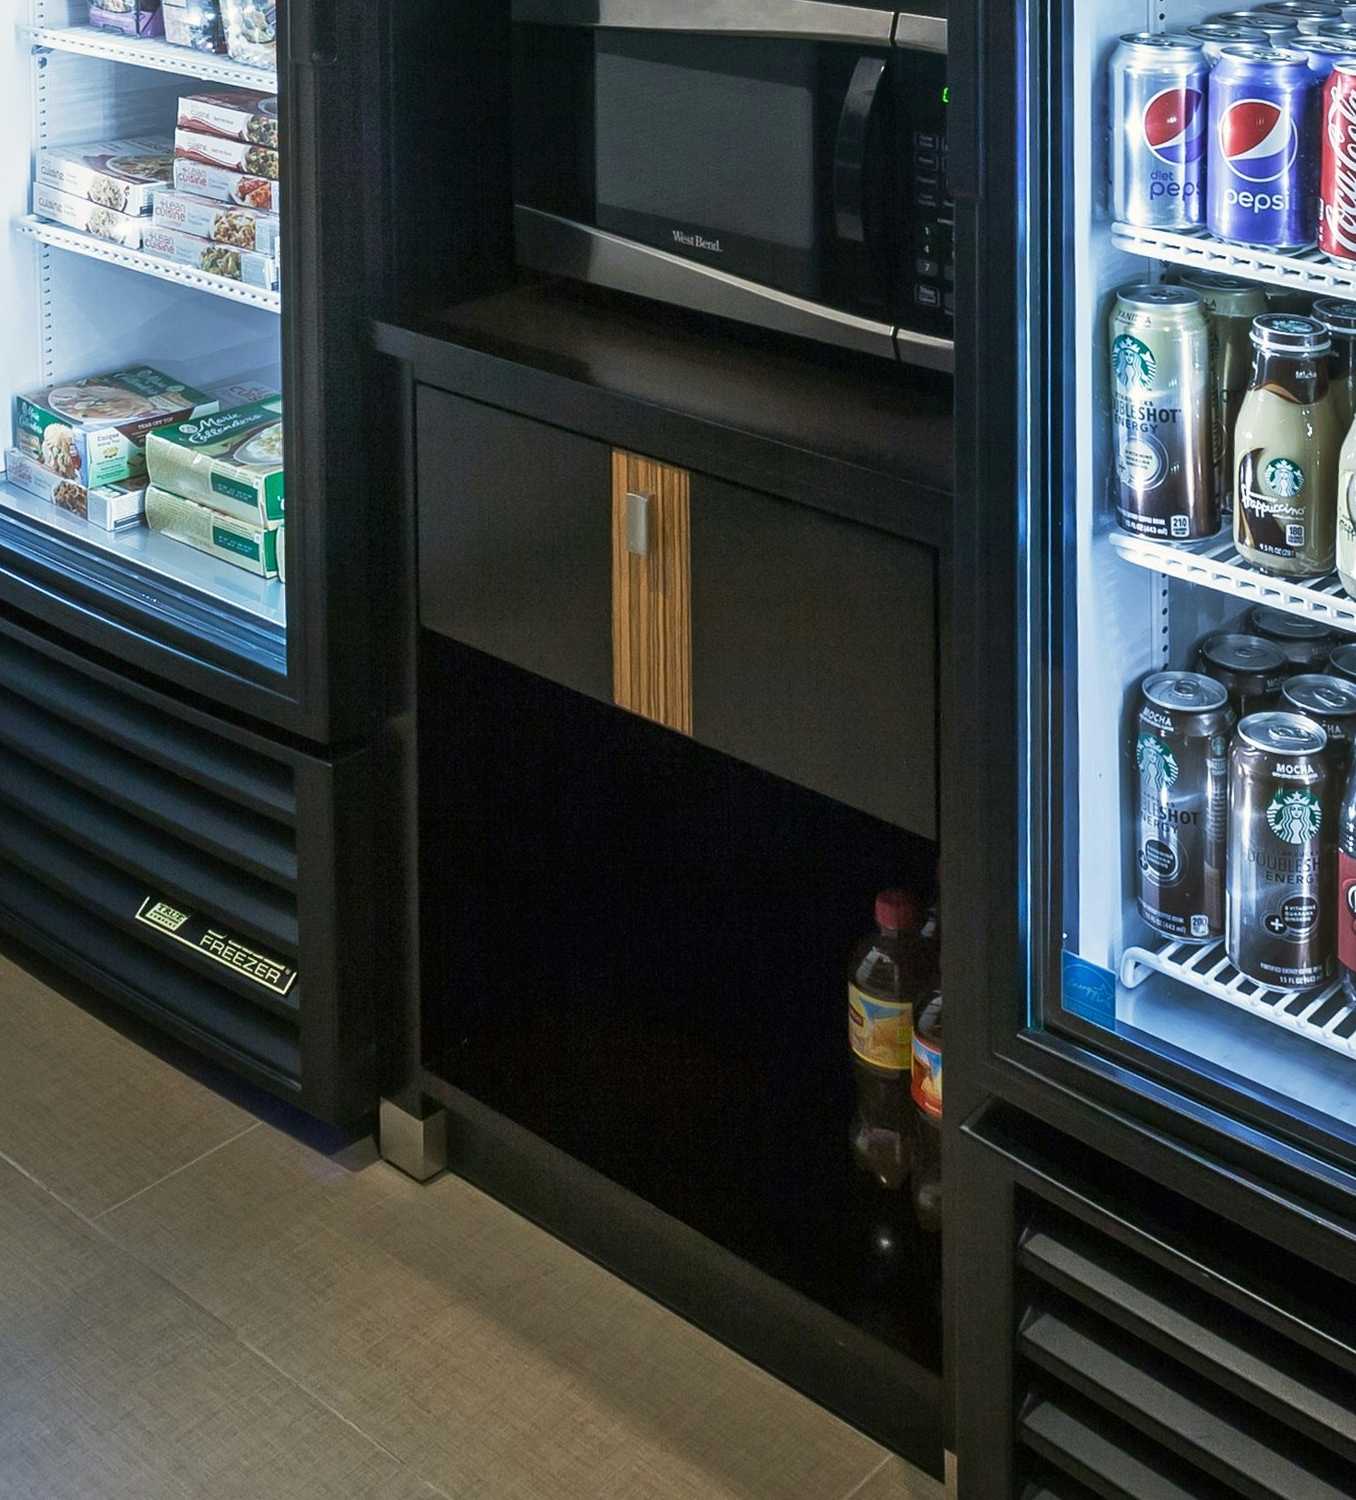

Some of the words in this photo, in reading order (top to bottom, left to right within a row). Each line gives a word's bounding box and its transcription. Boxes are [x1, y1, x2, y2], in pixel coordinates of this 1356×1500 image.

[177, 172, 207, 187] cuisine
[1150, 171, 1174, 181] diet
[1224, 188, 1290, 213] pepsi
[155, 207, 185, 222] cuisine
[144, 238, 175, 255] cuisine
[672, 230, 694, 247] West
[695, 235, 721, 252] Bend
[198, 410, 242, 433] Marie
[1173, 518, 1187, 527] 210
[1289, 526, 1303, 535] 180
[1143, 706, 1172, 727] MOCHA
[1276, 763, 1314, 775] MOCHA
[156, 904, 186, 923] TRUE
[199, 933, 281, 984] FREEZER
